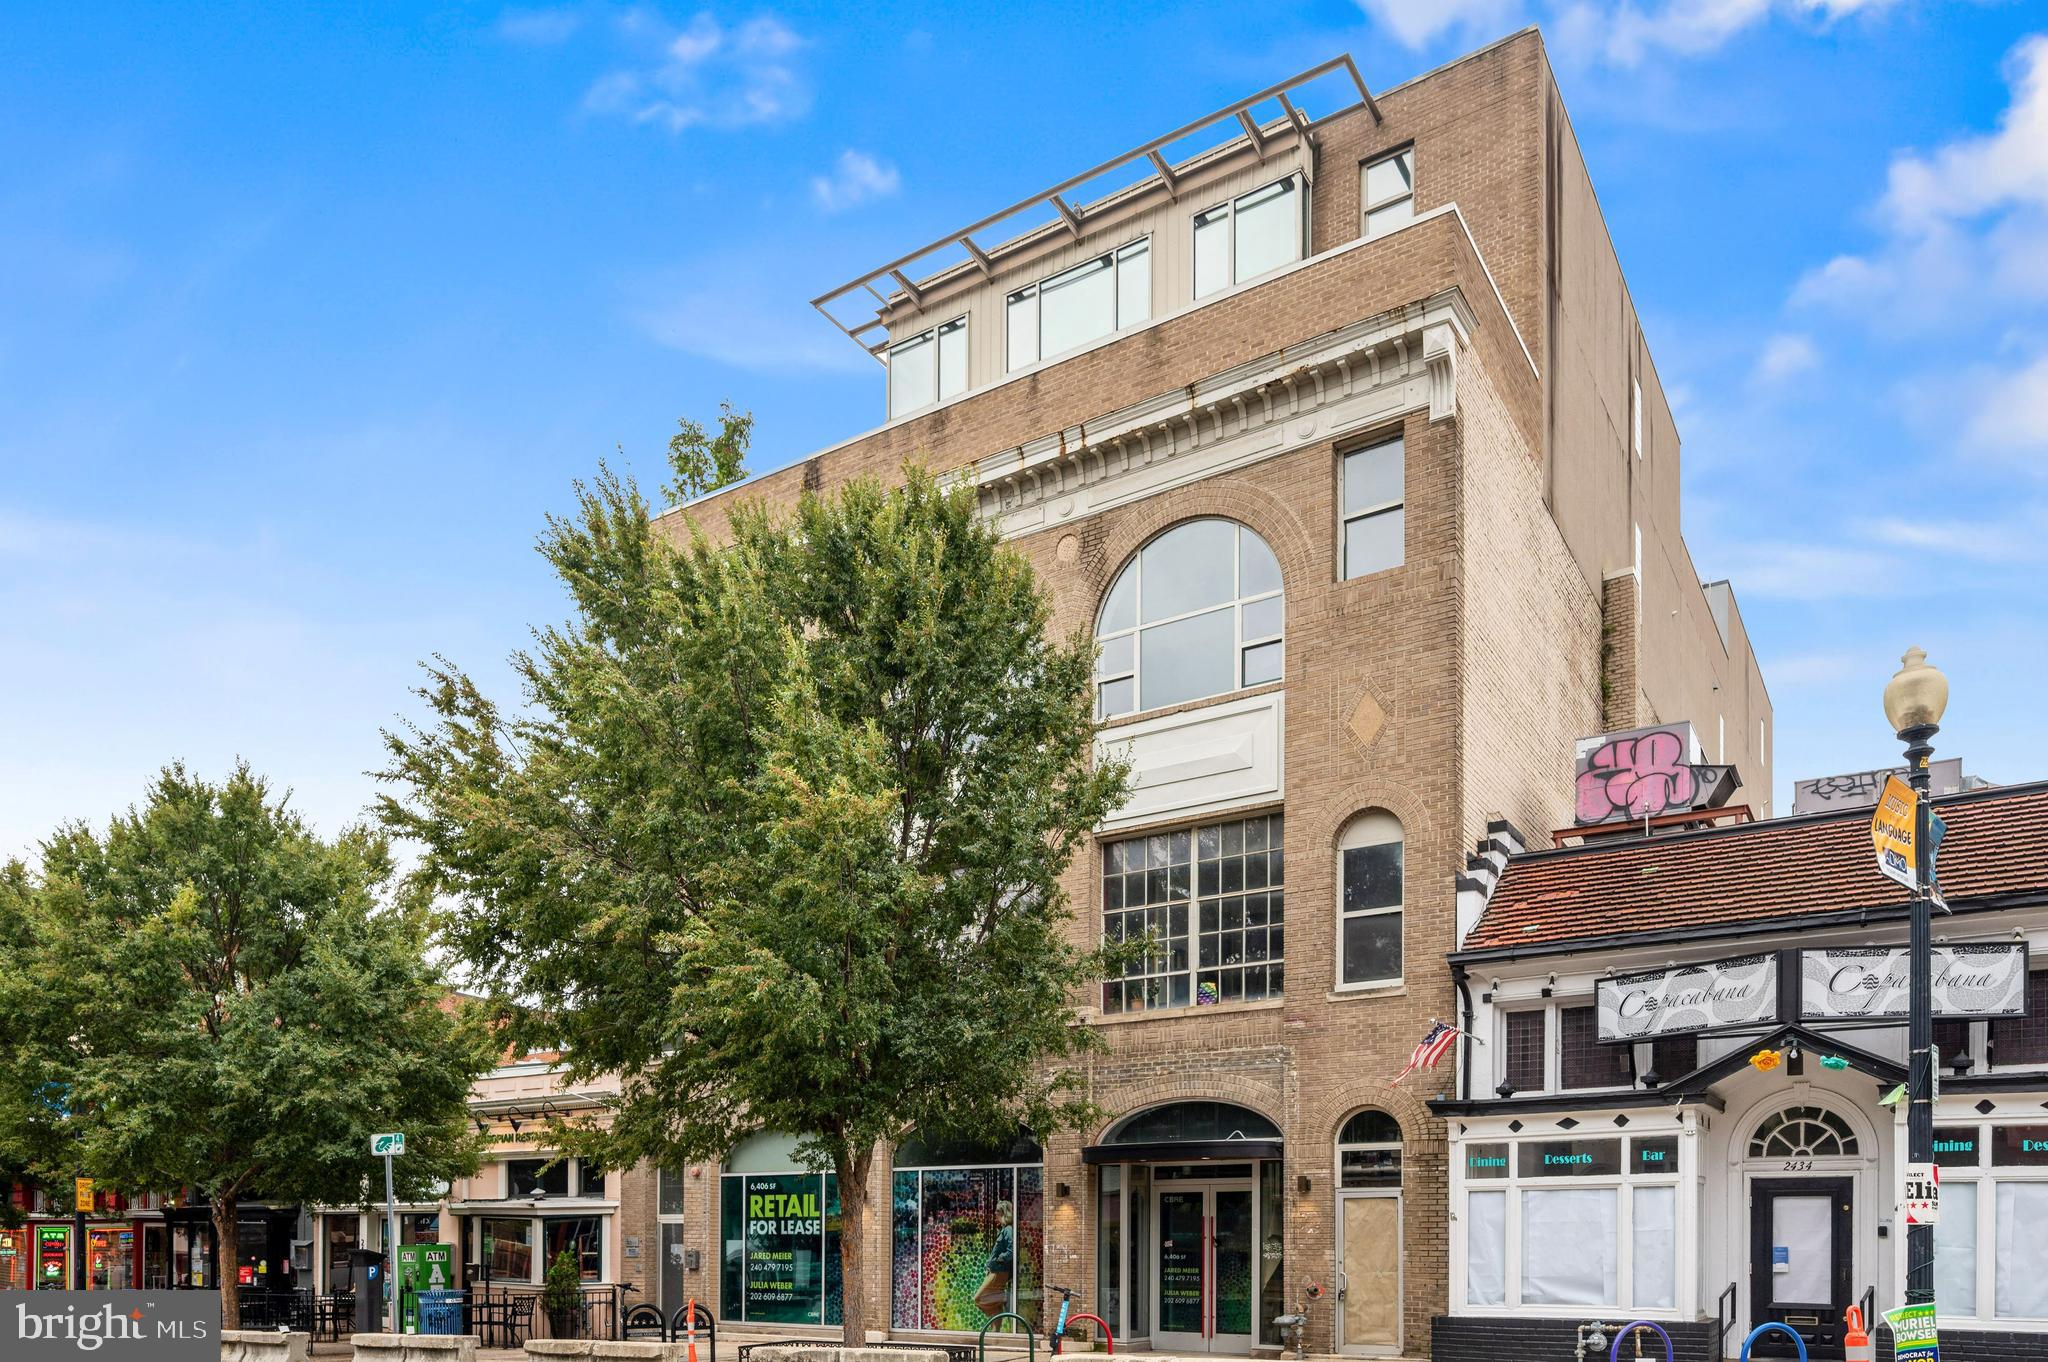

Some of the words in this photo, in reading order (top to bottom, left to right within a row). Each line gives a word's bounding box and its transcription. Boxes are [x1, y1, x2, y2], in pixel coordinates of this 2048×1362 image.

[1885, 794, 1908, 816] MUSIC
[1874, 818, 1912, 845] LANGUAGE
[1829, 957, 1991, 1009] Copabana
[1932, 1140, 1973, 1152] ining
[1544, 1152, 1593, 1165] Desserts
[1642, 1150, 1666, 1161] Bar
[1469, 1155, 1506, 1168] Dining
[1783, 1161, 1813, 1171] 2434
[750, 1183, 768, 1191] 6,406
[750, 1194, 820, 1218] RETAIL
[750, 1220, 778, 1235] FOR
[781, 1220, 820, 1235] LEASE
[403, 1253, 415, 1261] ATM
[427, 1252, 445, 1260] ATM
[750, 1252, 771, 1260] JARED
[772, 1252, 792, 1260] MEIER
[750, 1263, 762, 1271] 240
[763, 1263, 776, 1271] 479
[777, 1263, 793, 1271] 7195
[750, 1282, 769, 1290] JULIA
[770, 1282, 793, 1290] WEBER
[750, 1293, 762, 1301] 202
[763, 1293, 776, 1301] 609
[776, 1293, 793, 1301] 6877
[1893, 1316, 1936, 1333] MURIEL
[1896, 1329, 1937, 1343] BOWSER
[1897, 1351, 1926, 1361] DEMOCRAT
